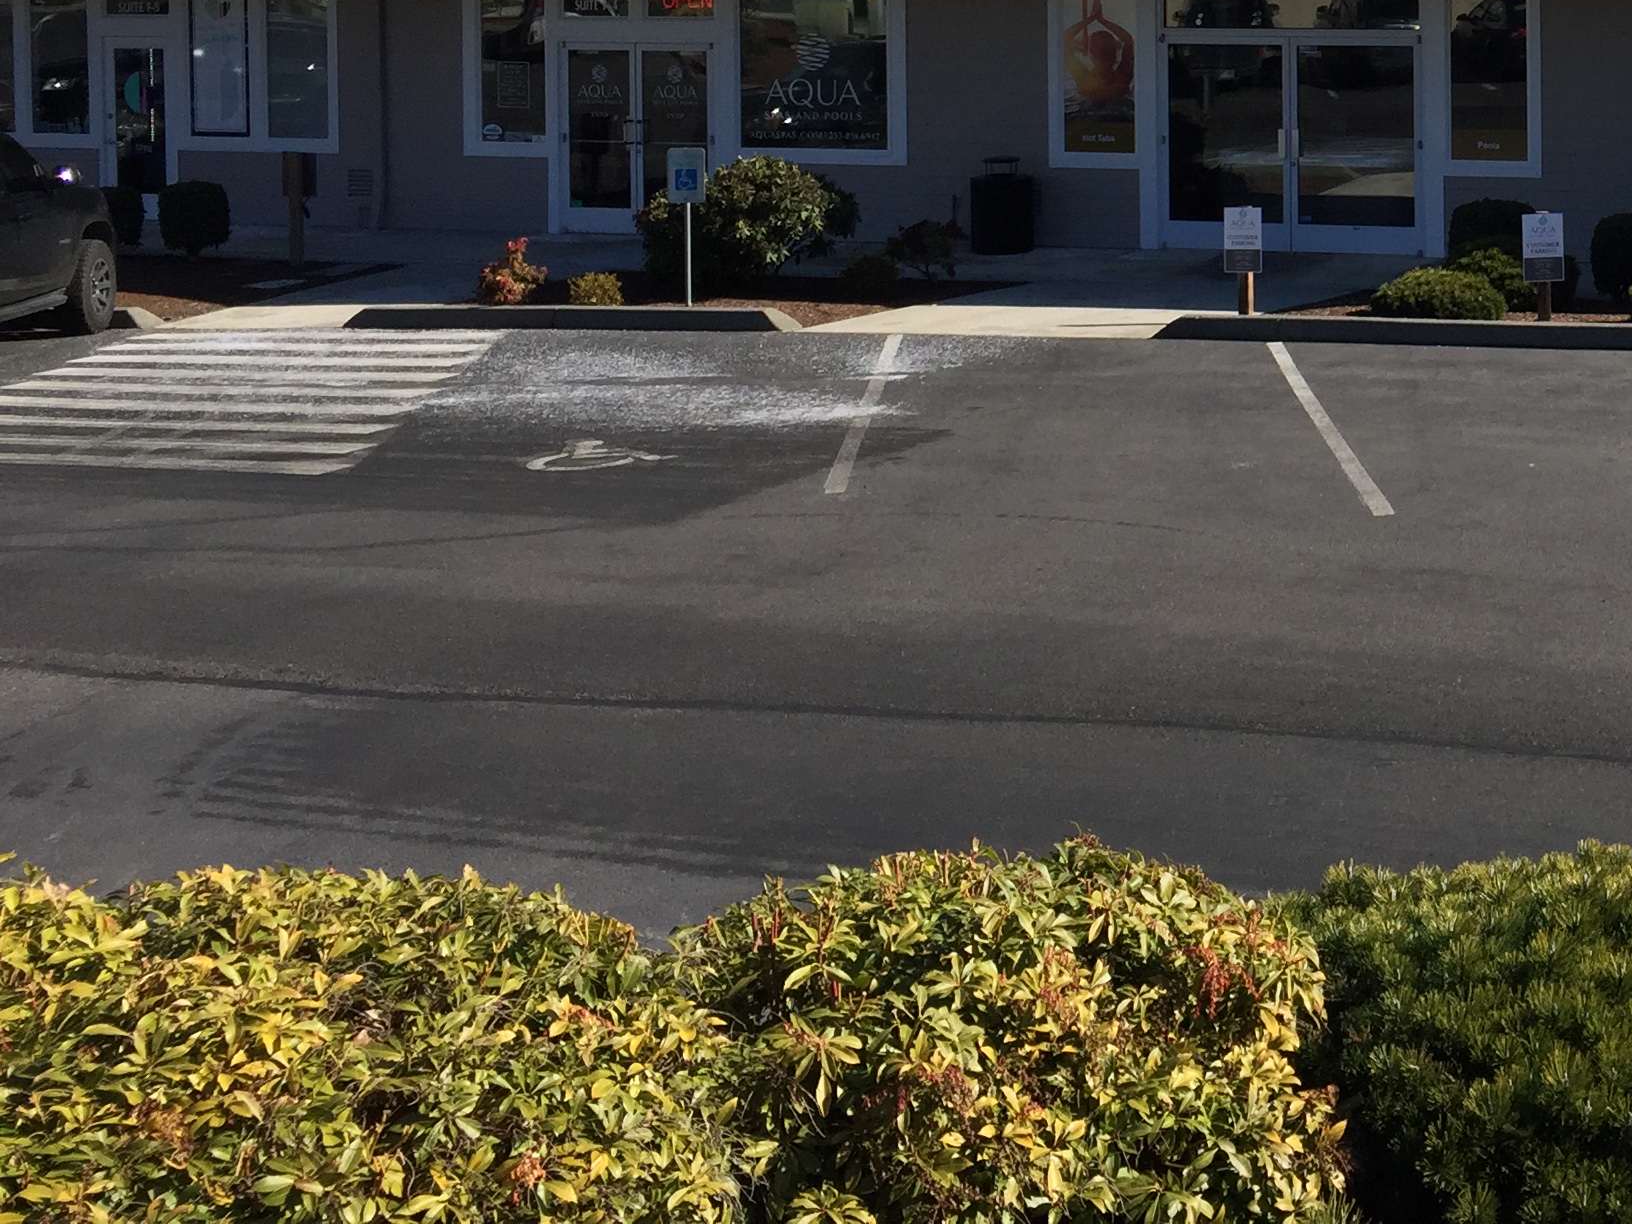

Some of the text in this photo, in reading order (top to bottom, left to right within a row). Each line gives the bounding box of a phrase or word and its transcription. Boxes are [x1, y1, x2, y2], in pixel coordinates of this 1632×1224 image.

[117, 1, 145, 13] SUITE
[574, 0, 599, 11] SUITE
[577, 84, 622, 99] AQUA
[653, 85, 698, 100] AQUA
[765, 78, 860, 108] AQUA
[797, 112, 820, 120] AND
[824, 111, 862, 121] POOLS
[1477, 140, 1501, 149] Pools
